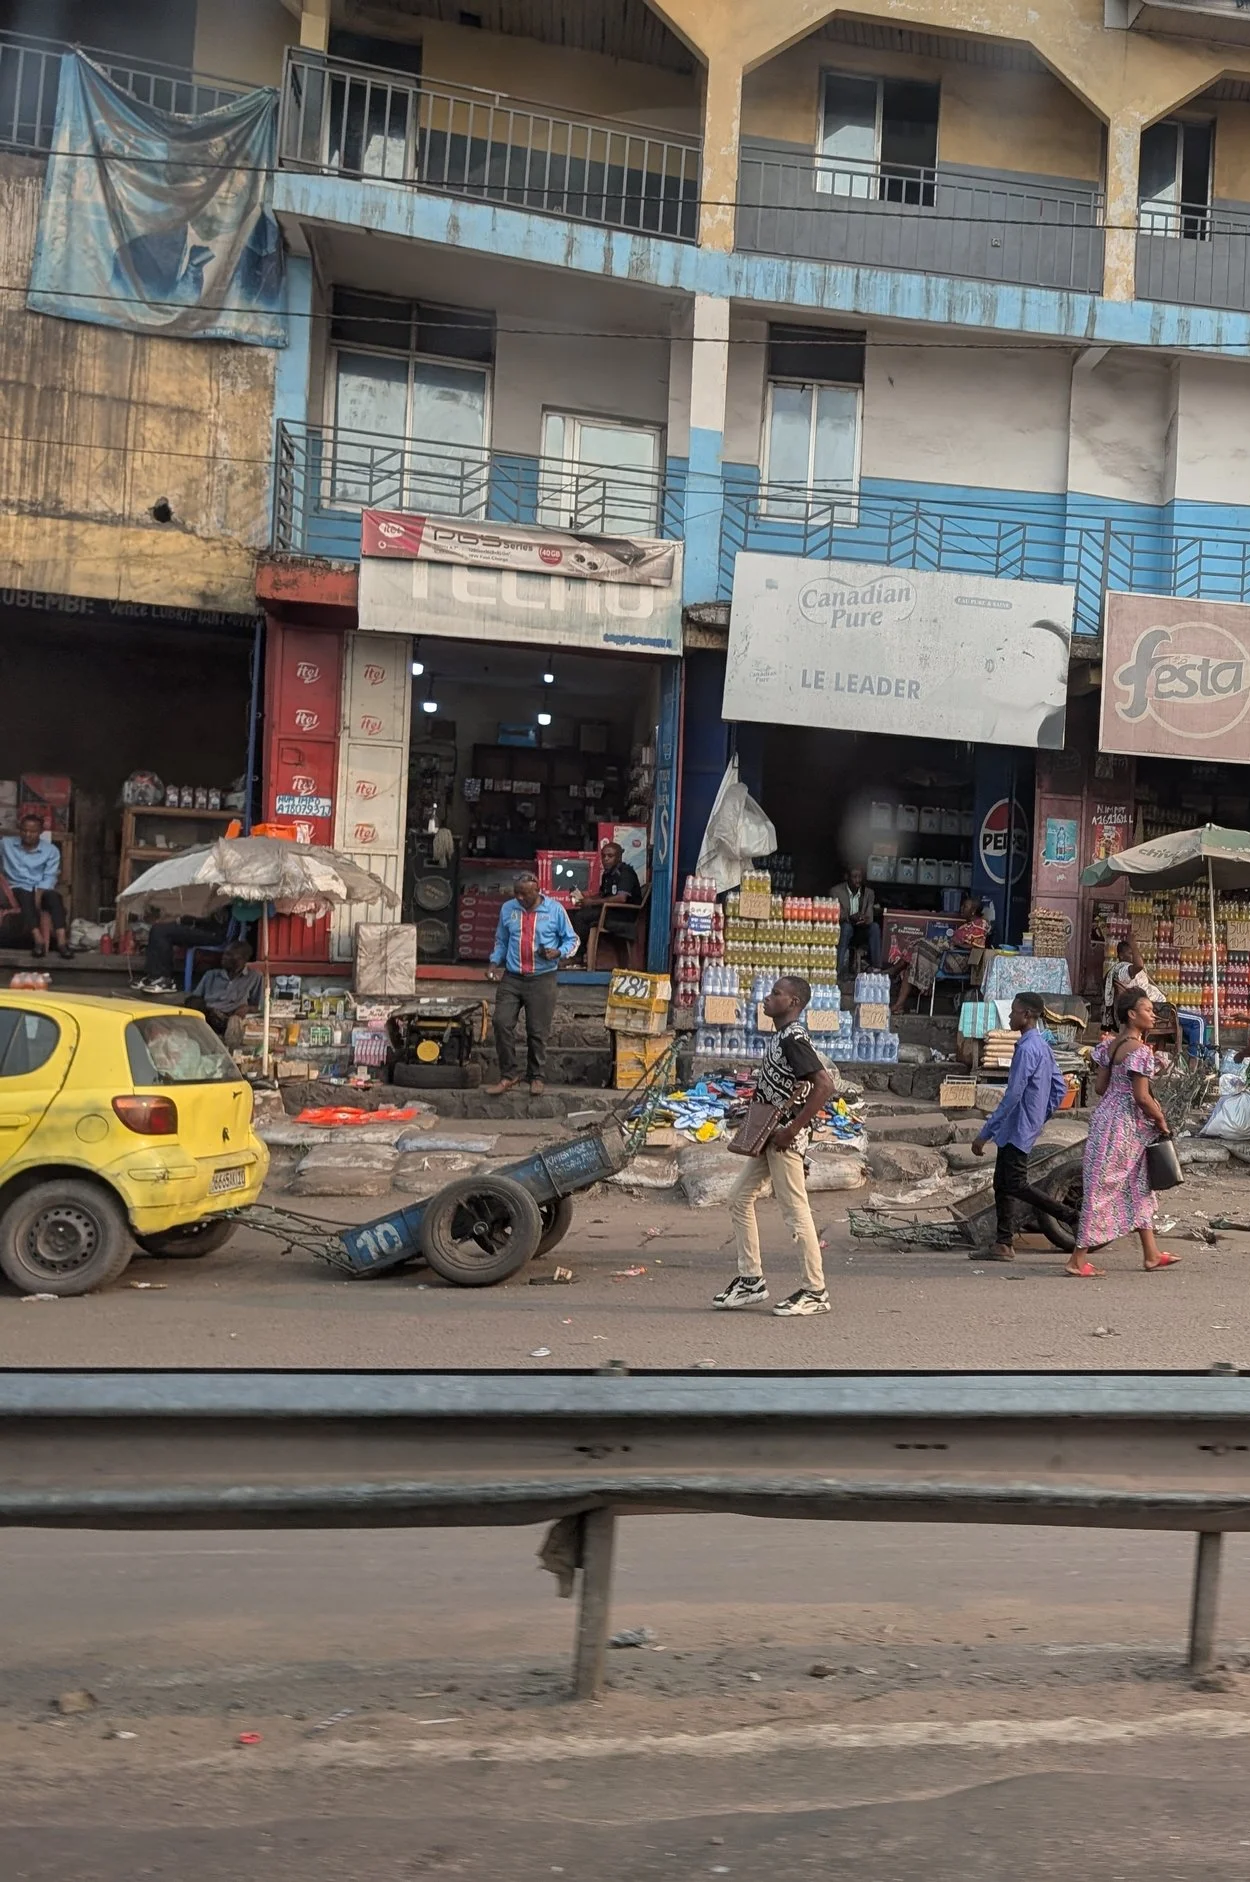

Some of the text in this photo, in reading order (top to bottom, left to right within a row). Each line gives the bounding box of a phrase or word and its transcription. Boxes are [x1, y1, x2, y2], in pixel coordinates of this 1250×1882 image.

[802, 584, 911, 609] Canadian
[830, 609, 883, 629] Pure
[801, 669, 921, 700] LE LEADER
[1118, 628, 1244, 719] festa
[355, 1222, 403, 1261] 10
